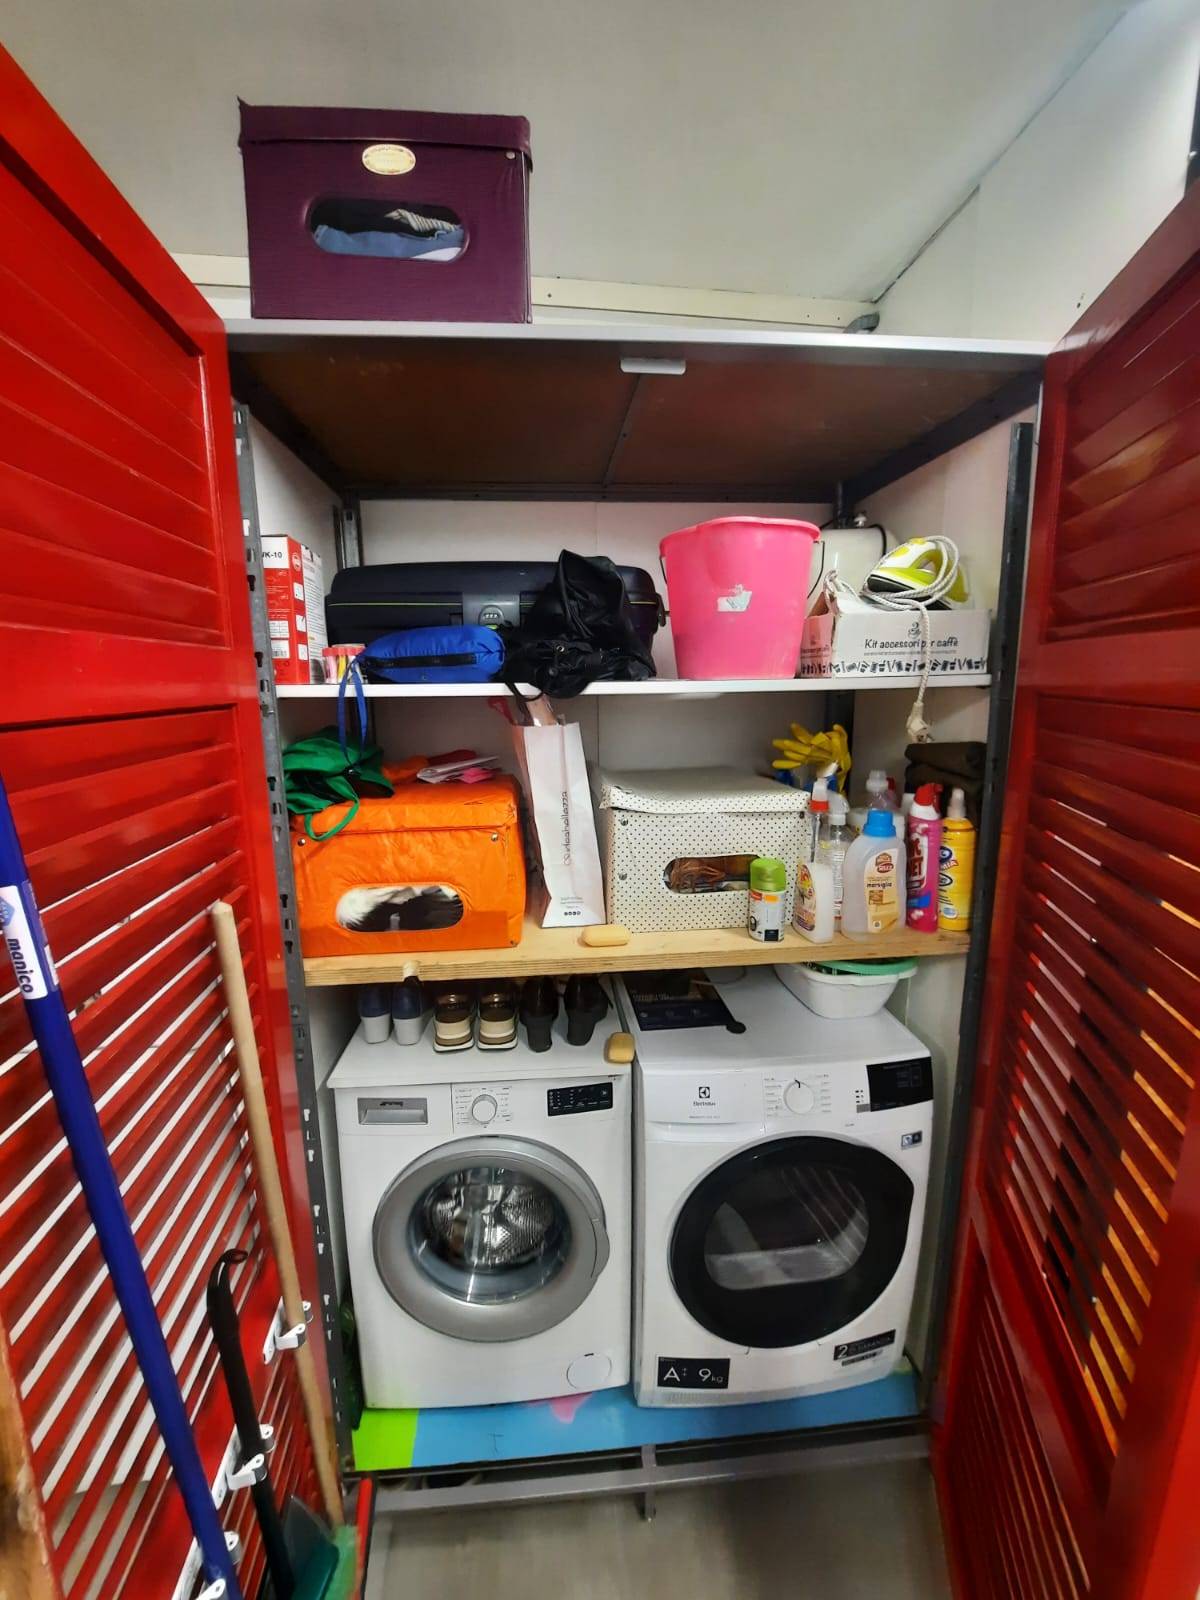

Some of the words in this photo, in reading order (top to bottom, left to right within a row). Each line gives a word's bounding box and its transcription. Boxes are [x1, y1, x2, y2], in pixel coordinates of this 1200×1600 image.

[864, 638, 878, 649] Kit
[879, 639, 920, 649] accessori
[920, 639, 935, 651] pr
[8, 938, 34, 993] manico
